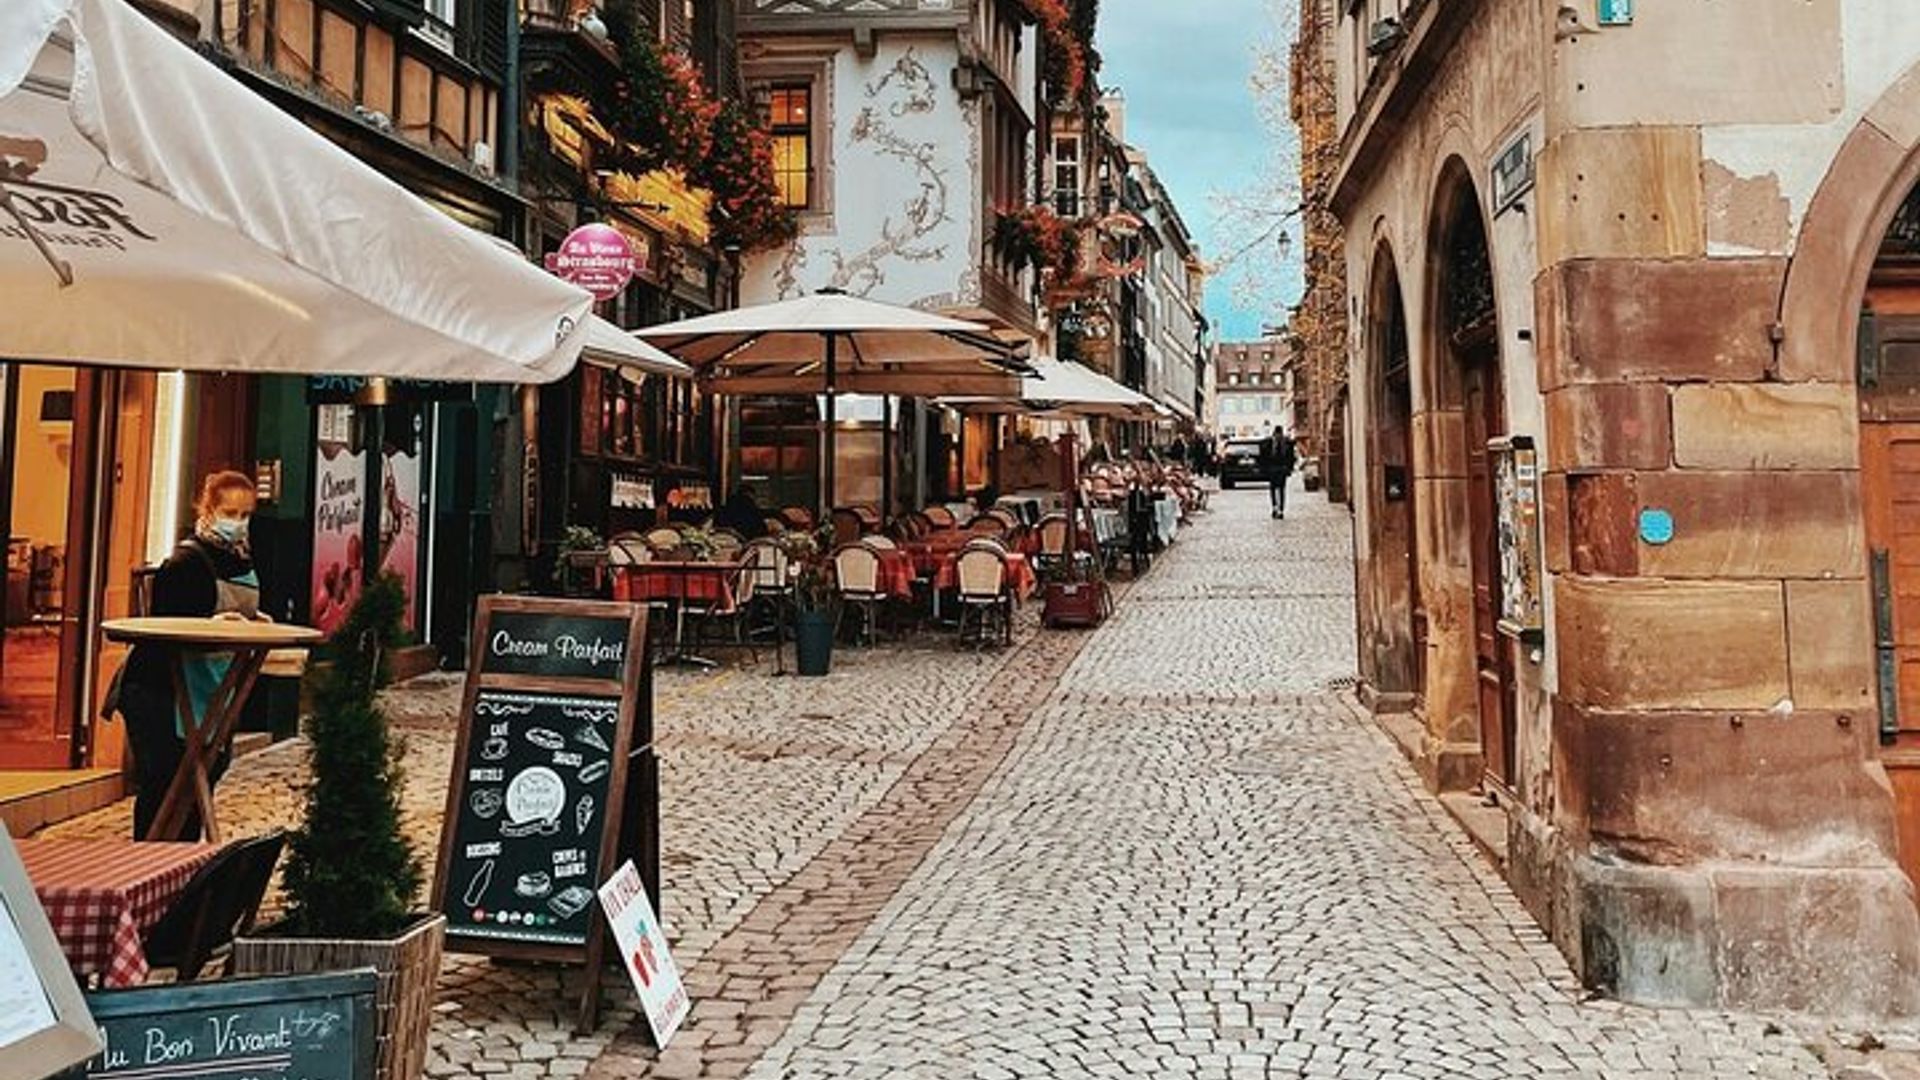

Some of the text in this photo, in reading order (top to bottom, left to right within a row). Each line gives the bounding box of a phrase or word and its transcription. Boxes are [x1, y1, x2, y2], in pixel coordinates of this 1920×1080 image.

[558, 255, 634, 270] Strasbourg
[322, 471, 356, 500] Cream
[492, 630, 623, 666] Cream Parfait
[145, 1028, 194, 1064] Bon
[208, 1015, 292, 1055] Vivant
